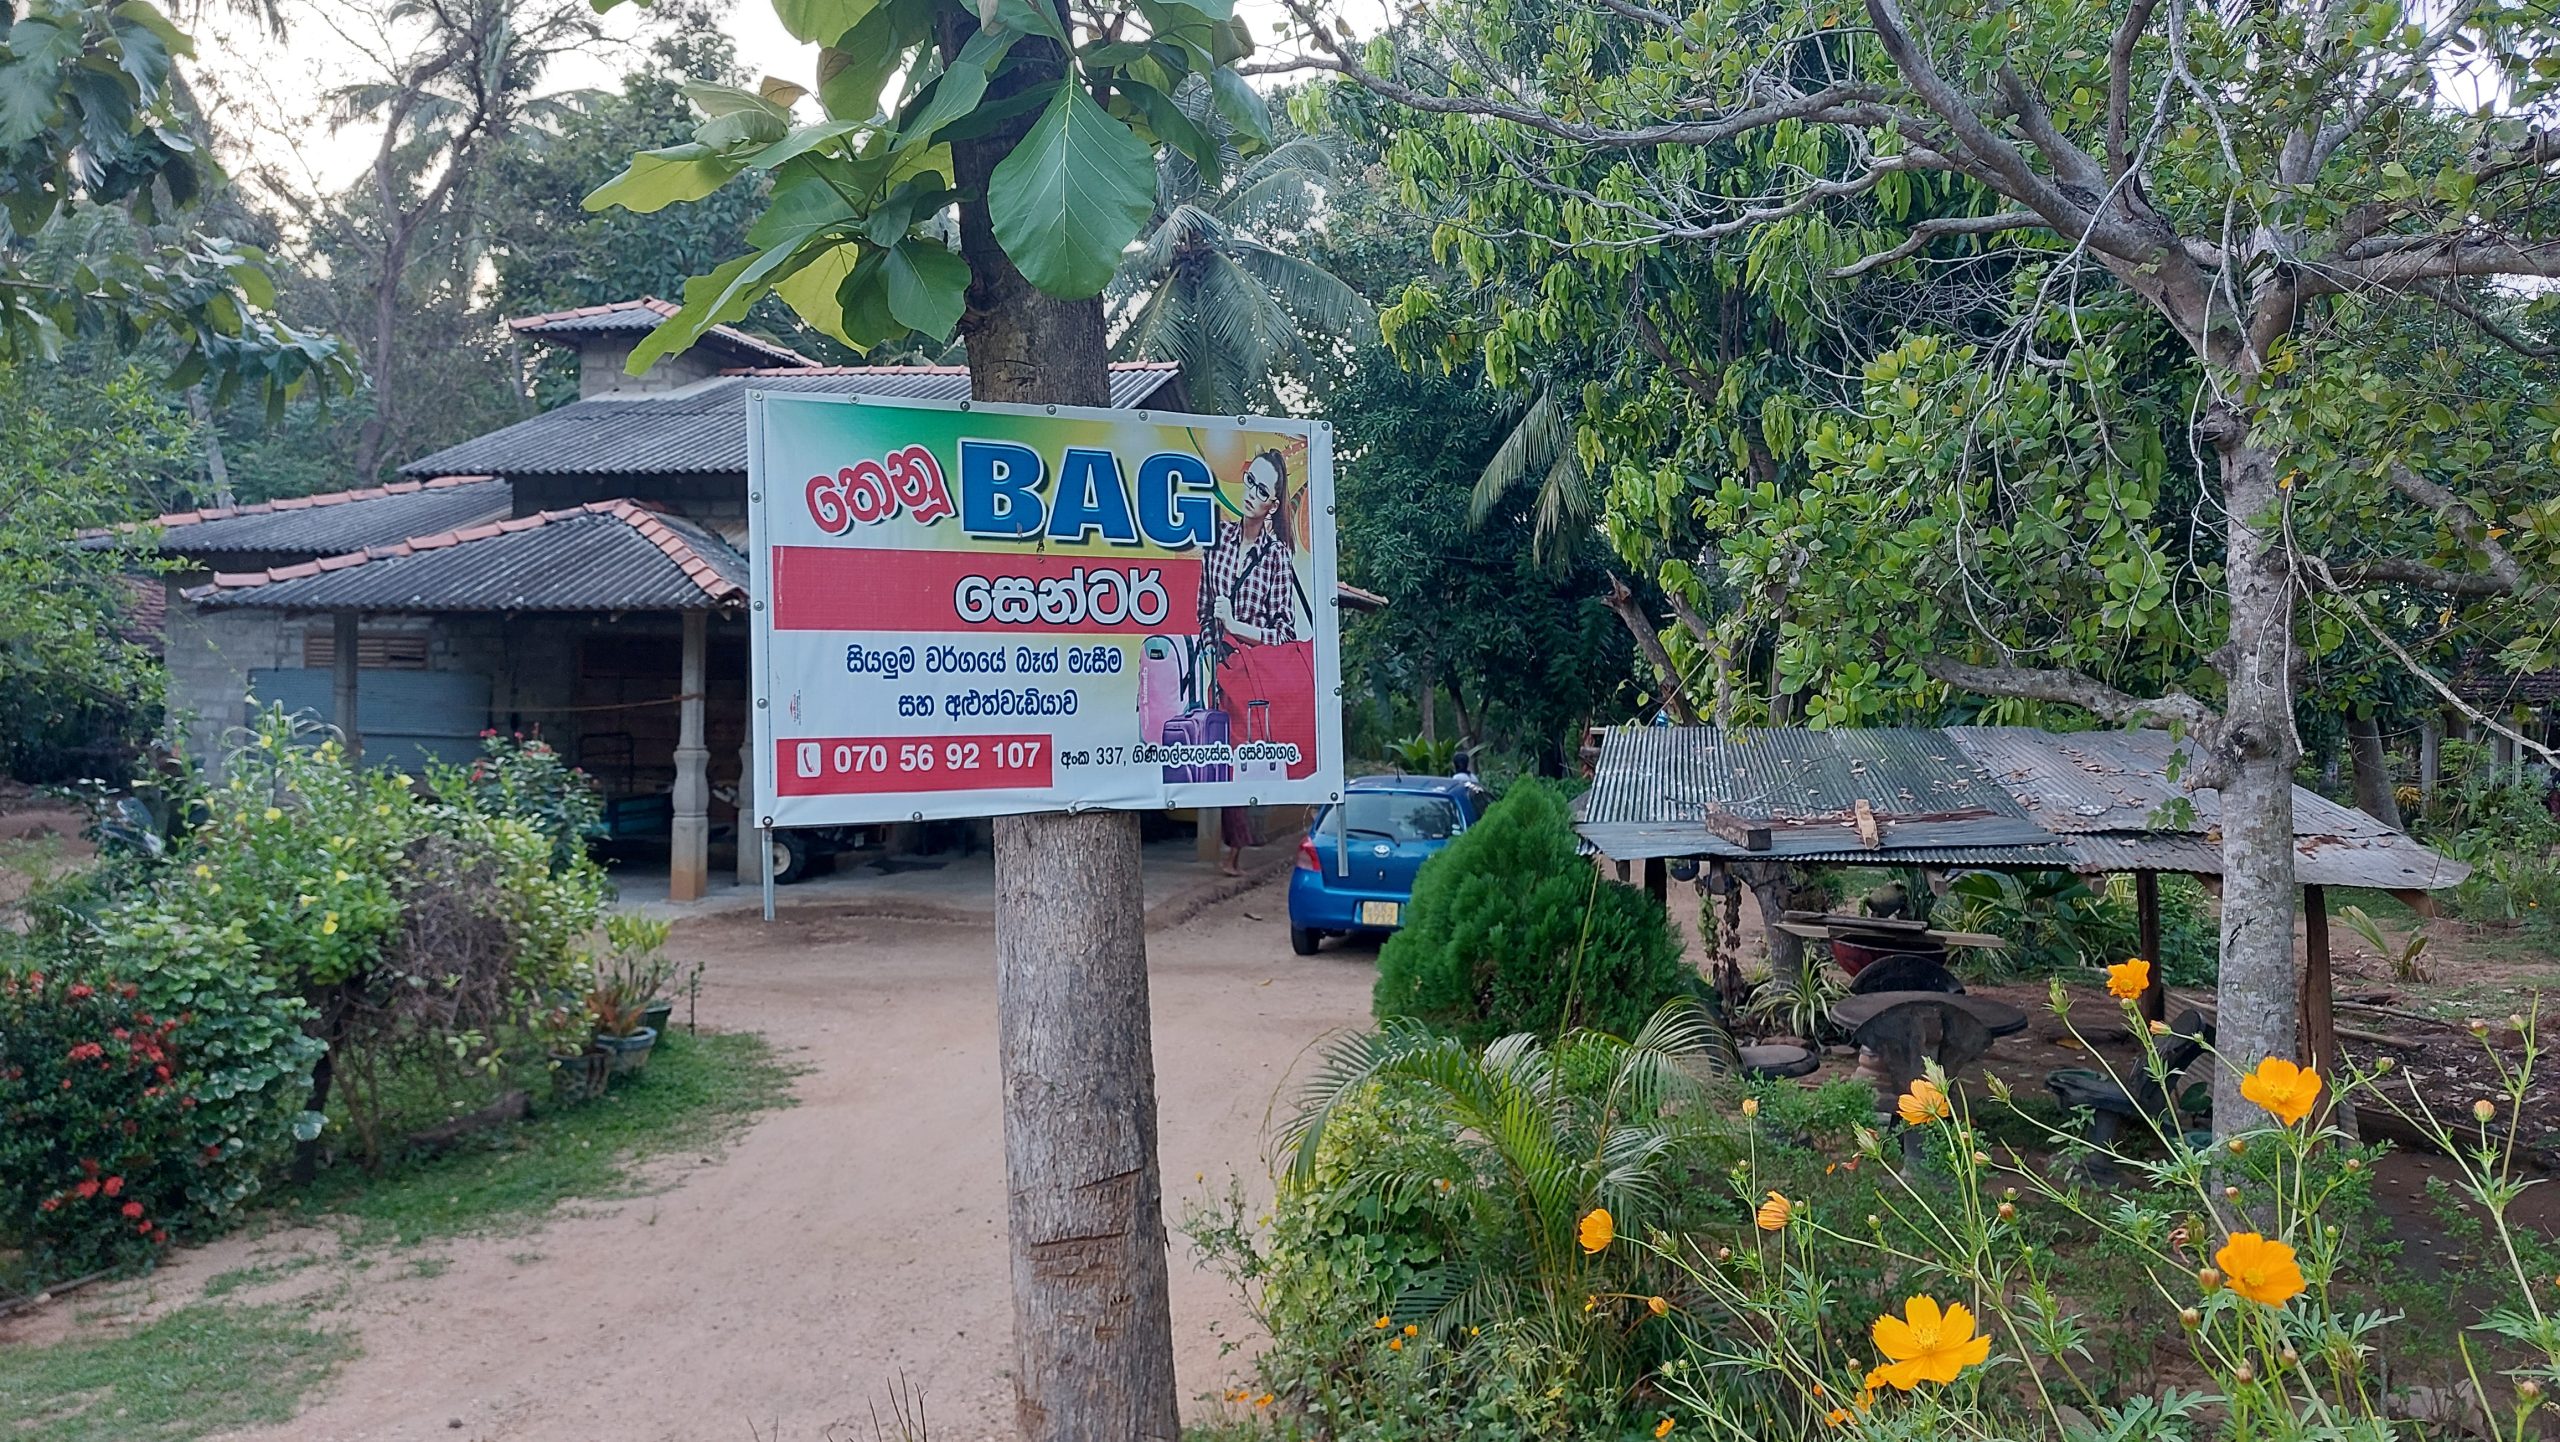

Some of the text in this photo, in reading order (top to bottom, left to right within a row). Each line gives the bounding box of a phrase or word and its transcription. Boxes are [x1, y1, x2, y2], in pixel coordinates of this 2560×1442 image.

[957, 437, 1217, 548] BAG
[954, 566, 1169, 626] සෙන්ටර්
[846, 643, 1122, 679] සියලුම වර්ගයේ බෑග් මැසීම
[898, 694, 935, 717] සහ
[834, 741, 1041, 773] 070 56 92 107
[1060, 750, 1089, 768] අංක
[1096, 747, 1127, 767] 337,
